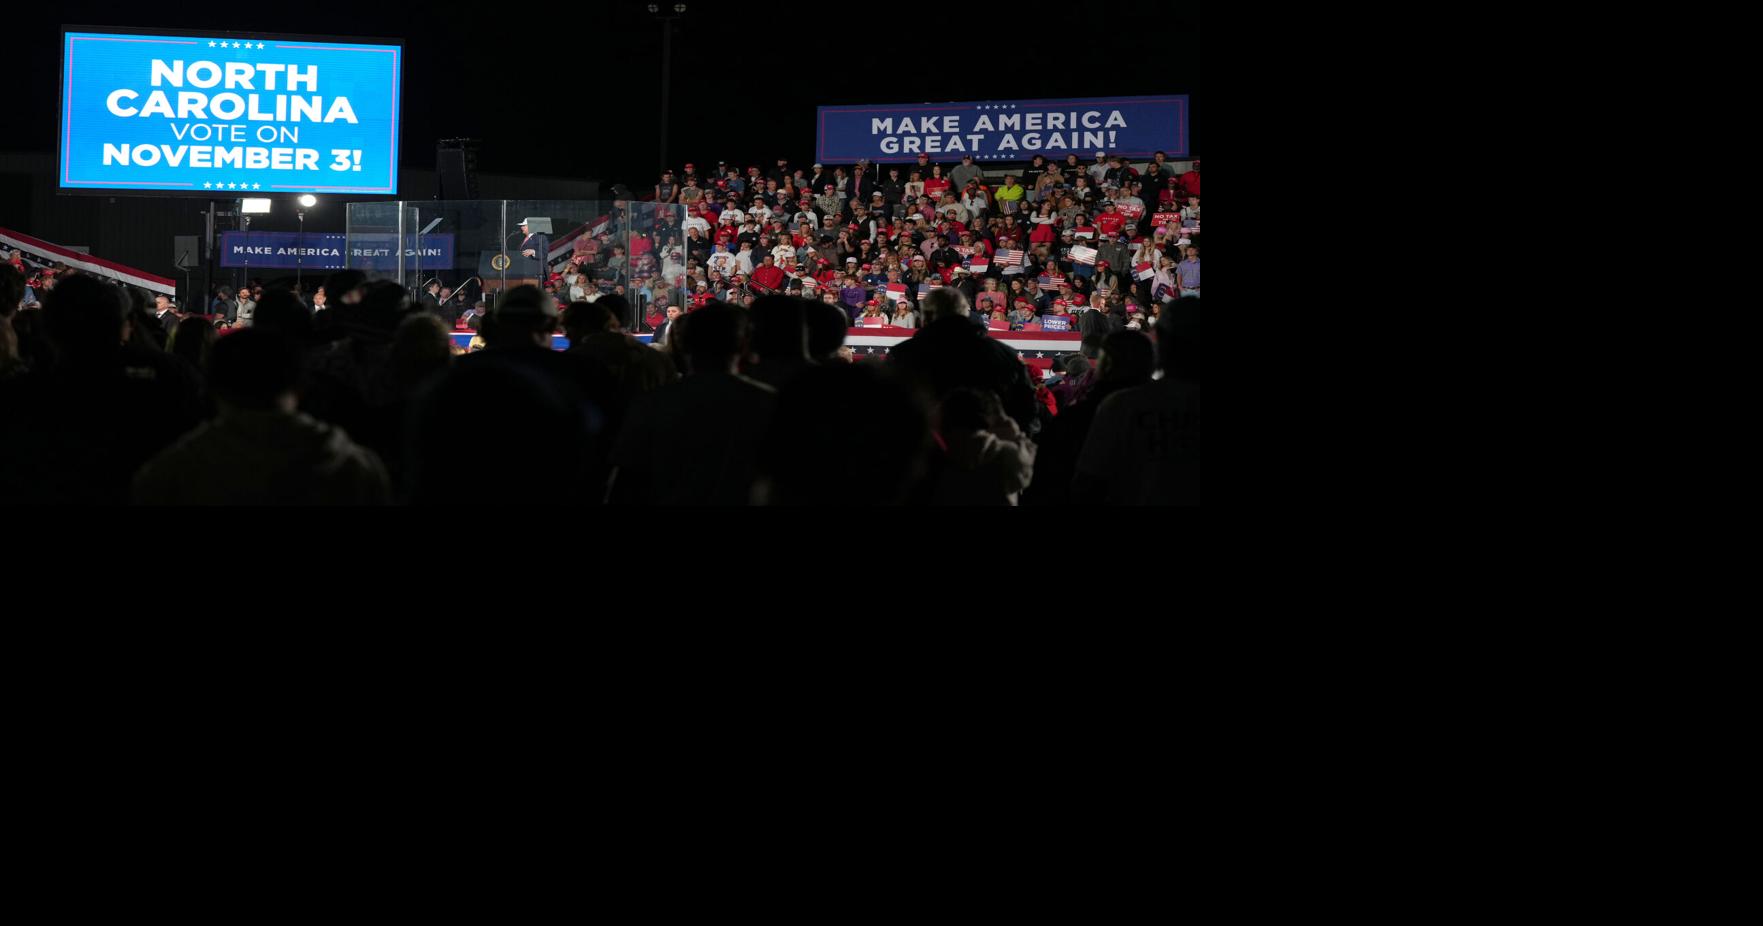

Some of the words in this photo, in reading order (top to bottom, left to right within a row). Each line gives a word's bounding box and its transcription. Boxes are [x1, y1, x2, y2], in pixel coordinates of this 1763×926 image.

[150, 59, 318, 92] NORTH
[106, 88, 359, 124] CAROLINA
[170, 123, 247, 143] VOTE
[256, 125, 299, 144] ON
[871, 116, 960, 135] MAKE
[973, 110, 1127, 132] AMERICA
[879, 134, 985, 154] GREAT
[997, 130, 1117, 151] AGAIN!
[102, 143, 320, 171] NOVEMBER
[329, 148, 362, 172] 3!
[233, 245, 272, 255] MAKE
[276, 247, 340, 257] AMERICA
